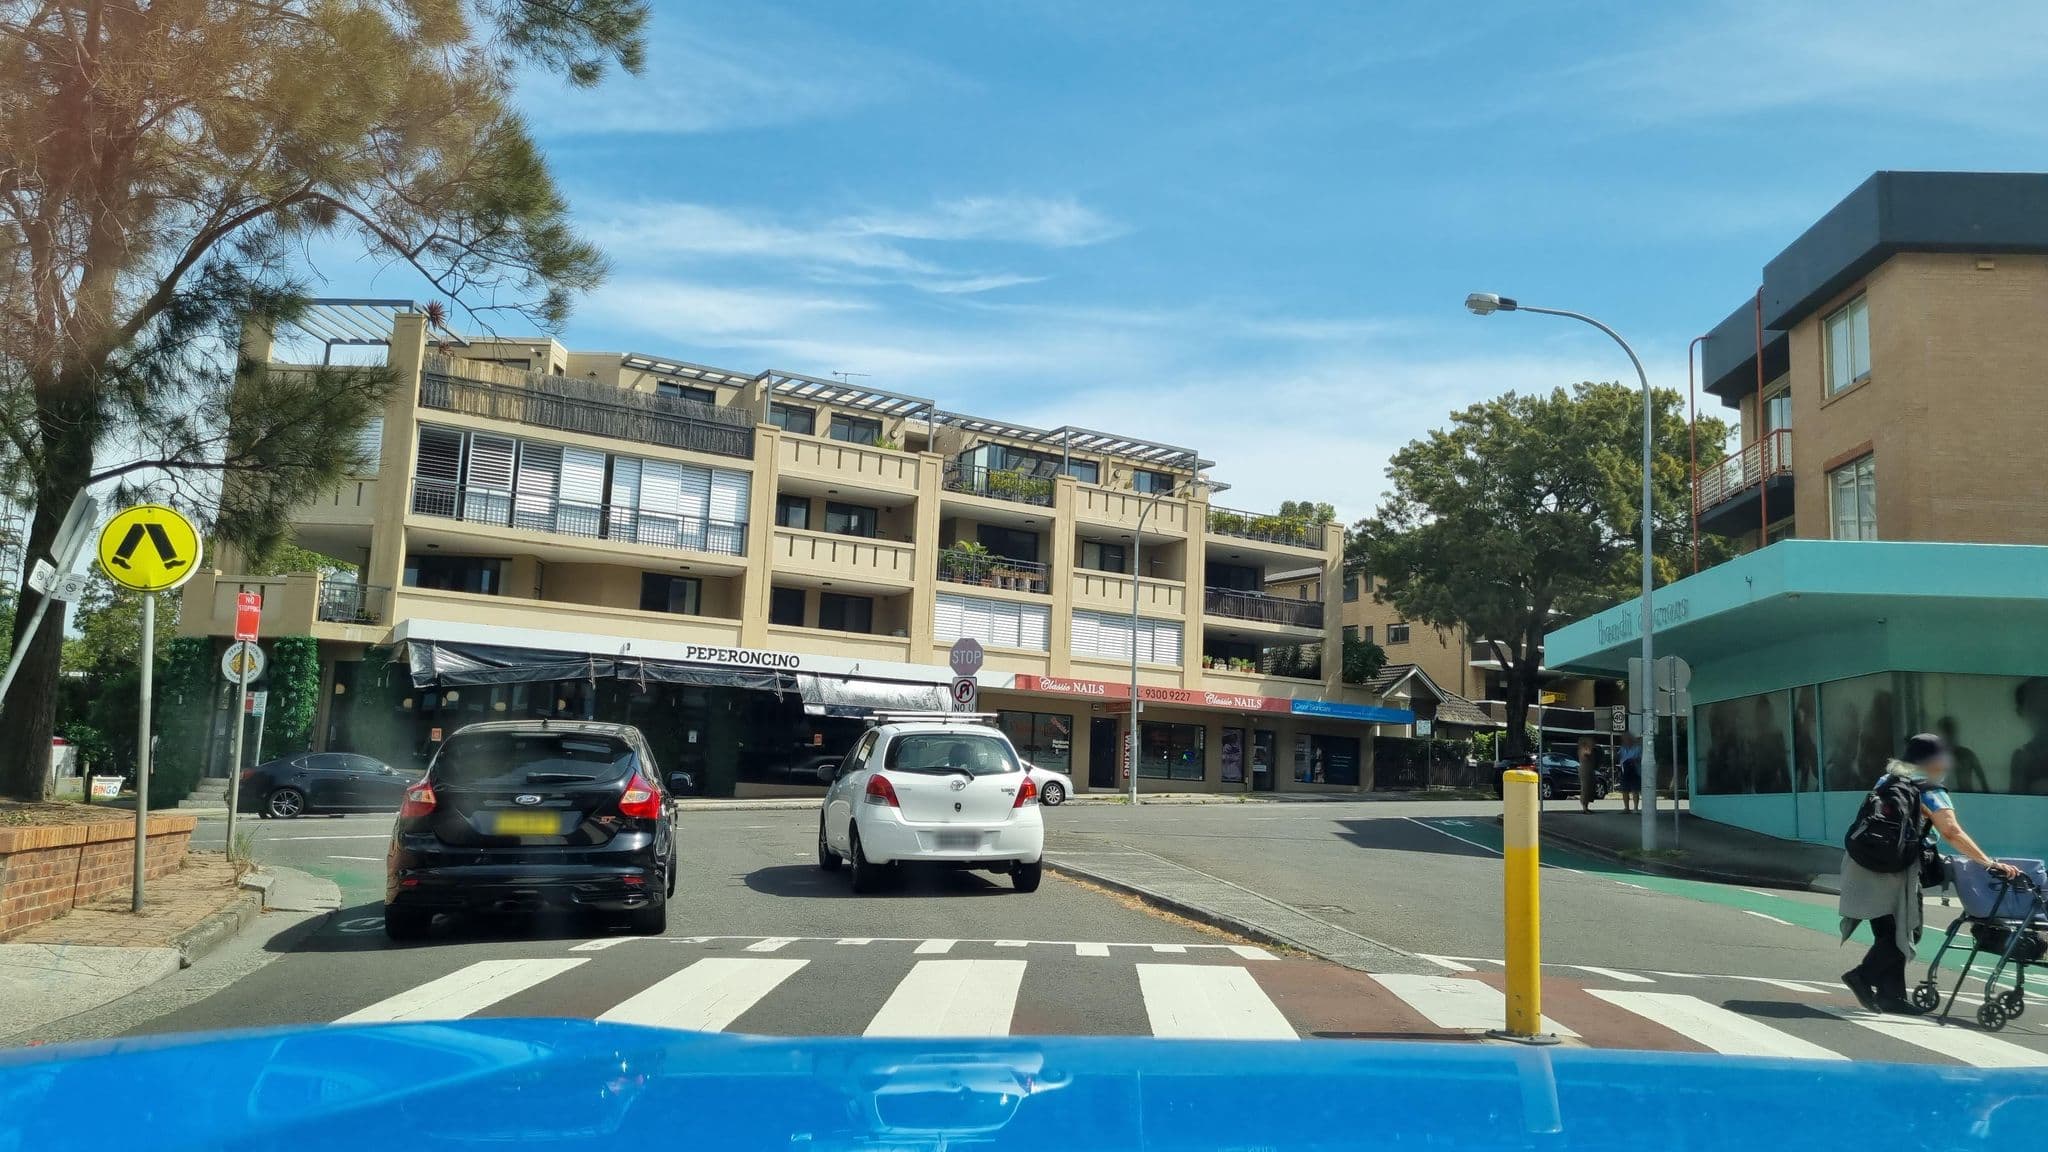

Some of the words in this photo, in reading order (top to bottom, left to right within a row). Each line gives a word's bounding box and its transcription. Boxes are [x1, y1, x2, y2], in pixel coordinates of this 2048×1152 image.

[245, 596, 254, 604] NO
[686, 646, 800, 668] PEPERONCINO
[952, 650, 982, 664] STOP
[1040, 676, 1071, 691] Classic
[1073, 682, 1104, 694] NAILS
[1127, 687, 1143, 698] TL:
[1145, 688, 1167, 700] 9300
[1169, 690, 1191, 702] 9227
[954, 704, 965, 712] NO
[969, 704, 974, 712] U
[1204, 692, 1232, 705] Classic
[1234, 697, 1262, 709] NAILS
[1123, 734, 1132, 777] WAXING
[94, 785, 118, 794] BINGO
